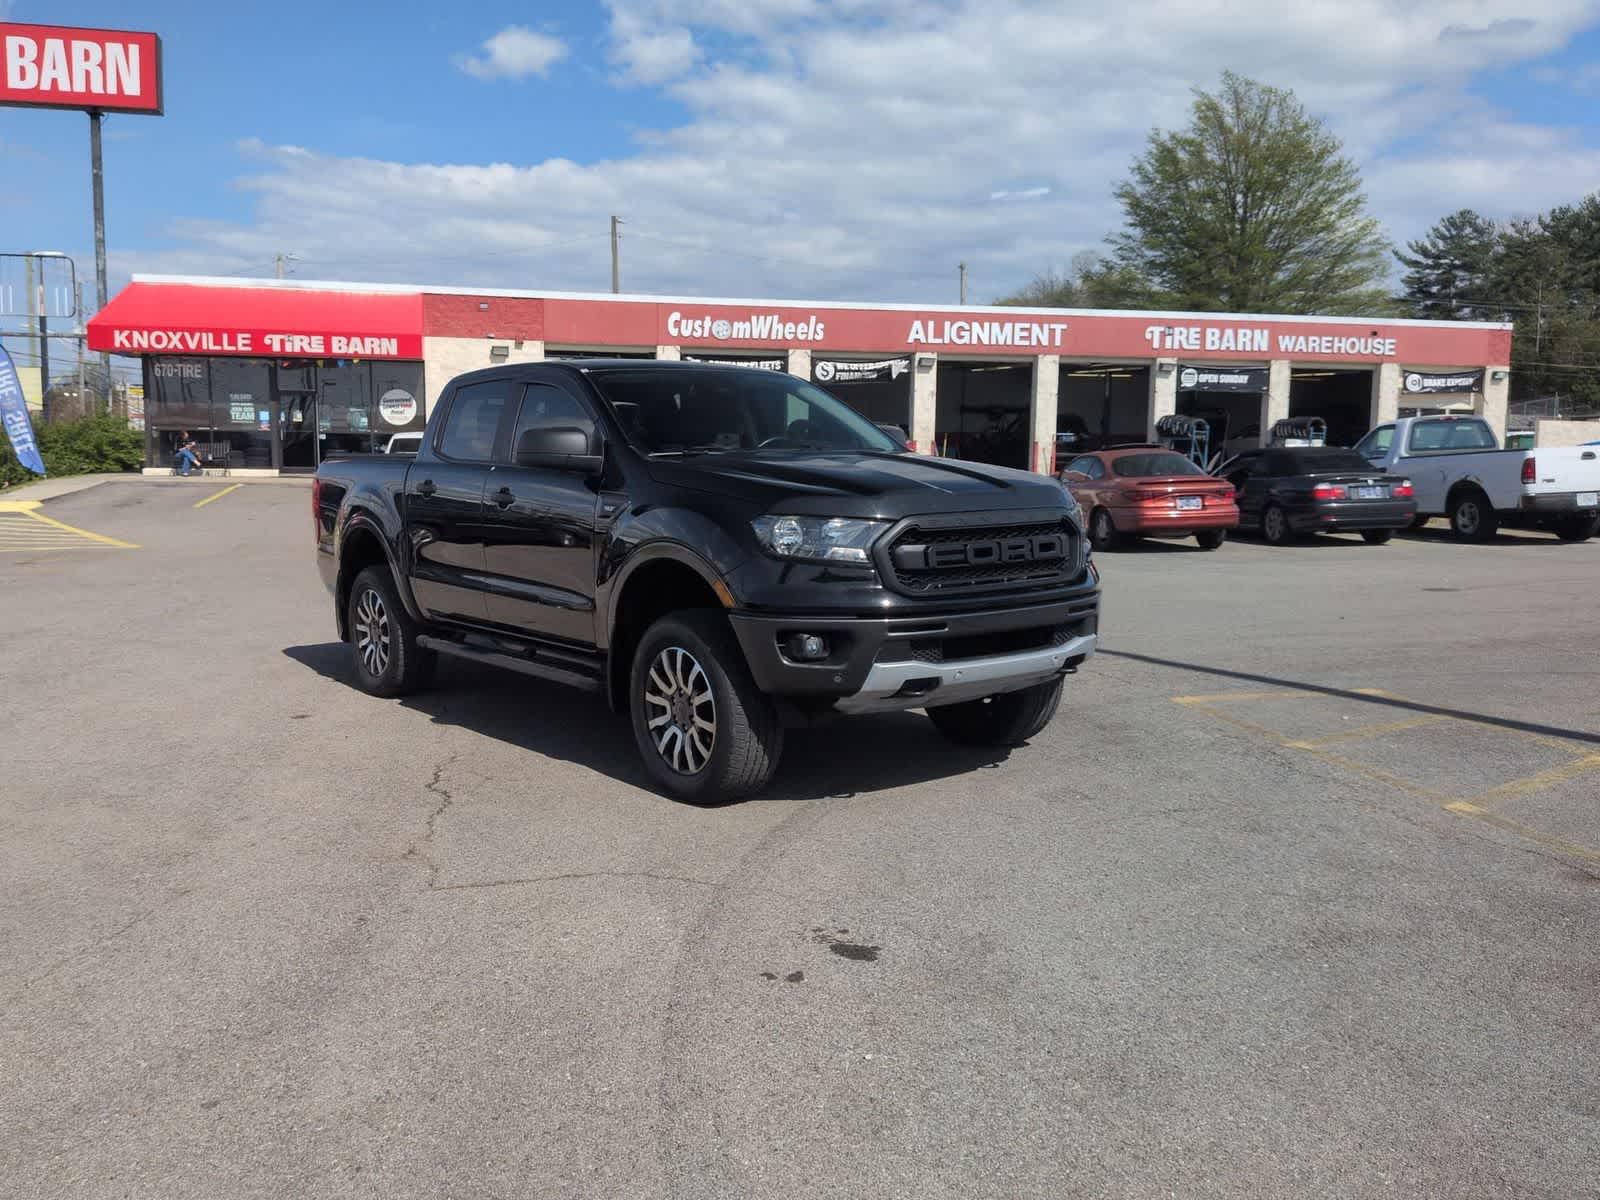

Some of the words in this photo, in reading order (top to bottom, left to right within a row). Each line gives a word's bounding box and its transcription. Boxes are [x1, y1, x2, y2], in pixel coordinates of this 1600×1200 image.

[5, 35, 141, 96] BARN
[113, 329, 252, 351] KNOXVILLE
[330, 336, 398, 355] BARN
[907, 319, 1067, 346] ALIGNMENT
[1204, 327, 1269, 351] BARN
[1278, 335, 1397, 355] WAREHOUSE
[154, 363, 202, 378] 670-TIRE
[231, 412, 255, 420] TEAM
[928, 535, 1066, 569] FORD
